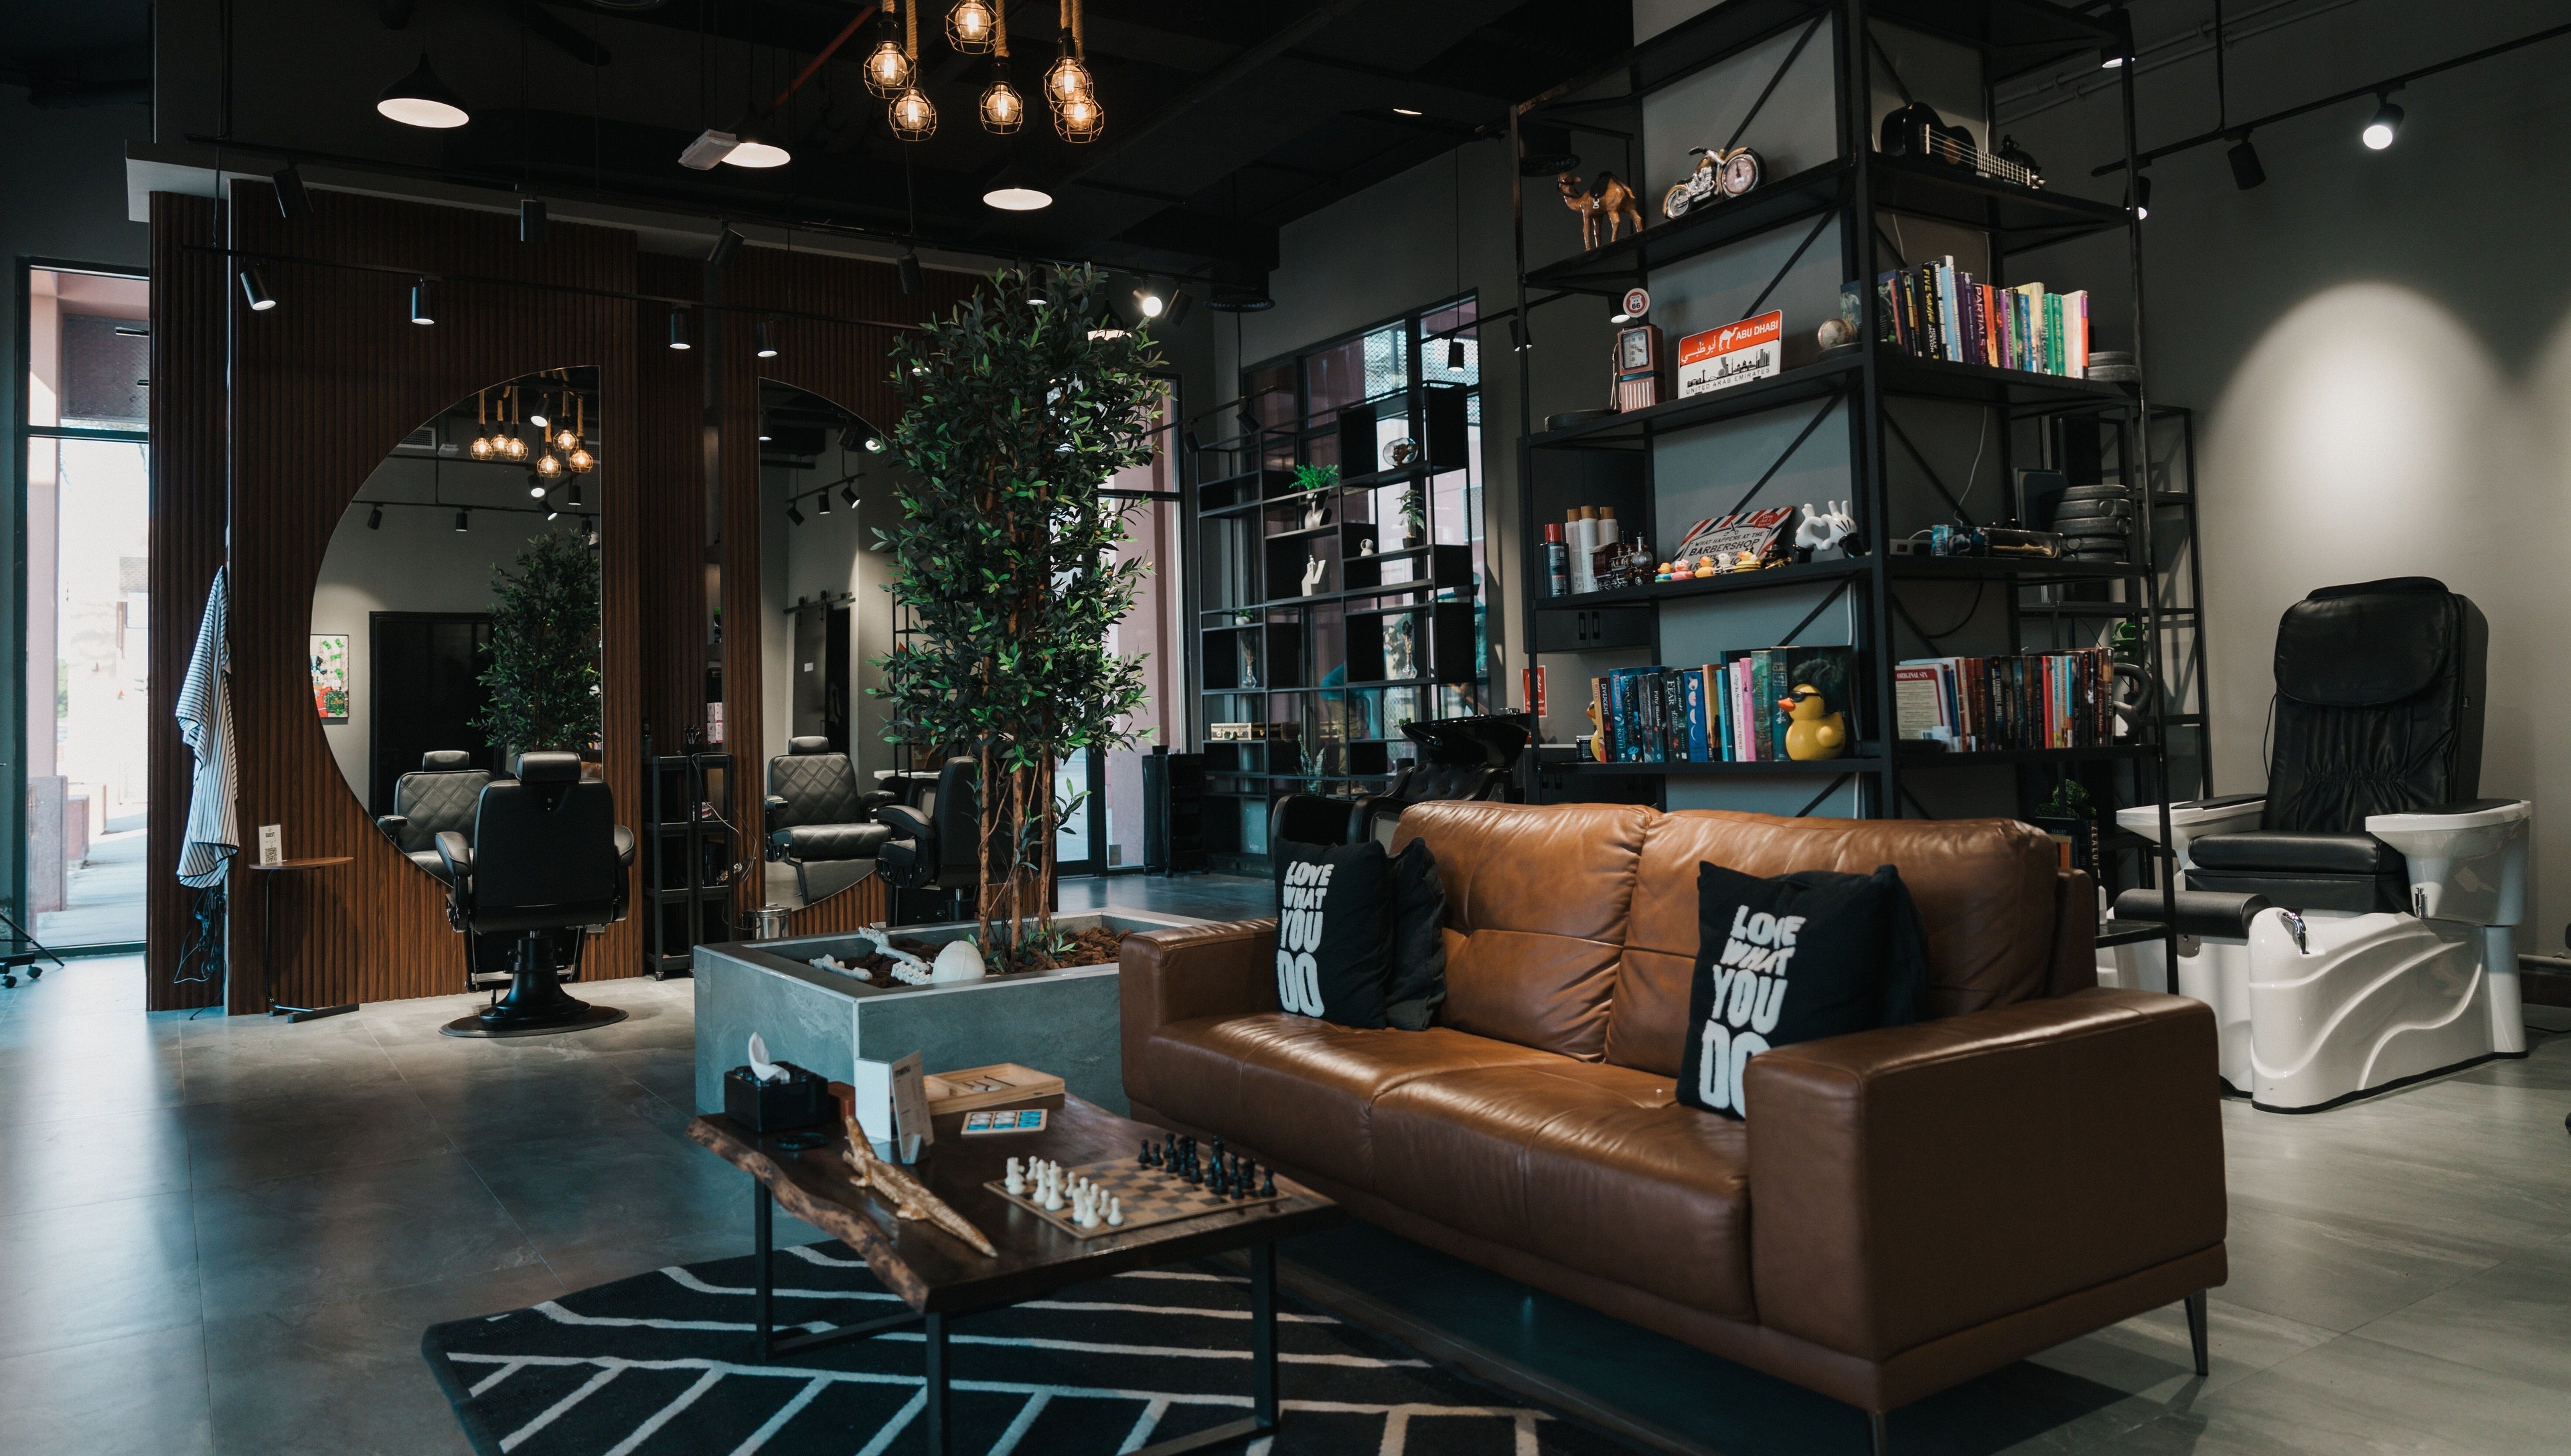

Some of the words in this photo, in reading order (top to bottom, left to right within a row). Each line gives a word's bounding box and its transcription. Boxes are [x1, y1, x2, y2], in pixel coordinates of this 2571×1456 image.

[1923, 269, 1932, 291] FIVE
[1975, 287, 1986, 347] PARTIALS
[1735, 328, 1751, 341] ABU
[1754, 320, 1778, 336] DHABI
[1686, 383, 1710, 394] UNITED
[1713, 376, 1731, 386] ARAB
[1735, 368, 1770, 382] EMIRATES
[1689, 538, 1760, 556] BARBERSHOP
[1713, 535, 1740, 544] HAPPENS
[1601, 683, 1609, 715] DIVERGENT
[1613, 675, 1622, 709] ALLEGIANT
[1666, 680, 1675, 705] FEAR
[1756, 675, 1764, 701] Chain
[1758, 705, 1764, 713] of
[1758, 717, 1766, 738] Gold
[2091, 826, 2099, 866] ZEALOT
[1284, 860, 1334, 886] LOVE
[1283, 885, 1327, 909] WHAT
[1280, 908, 1324, 953] YOU
[1730, 904, 1806, 950] LOVE
[1720, 937, 1796, 976] WHAT
[1276, 949, 1325, 1018] DO
[1711, 964, 1788, 1034] YOU
